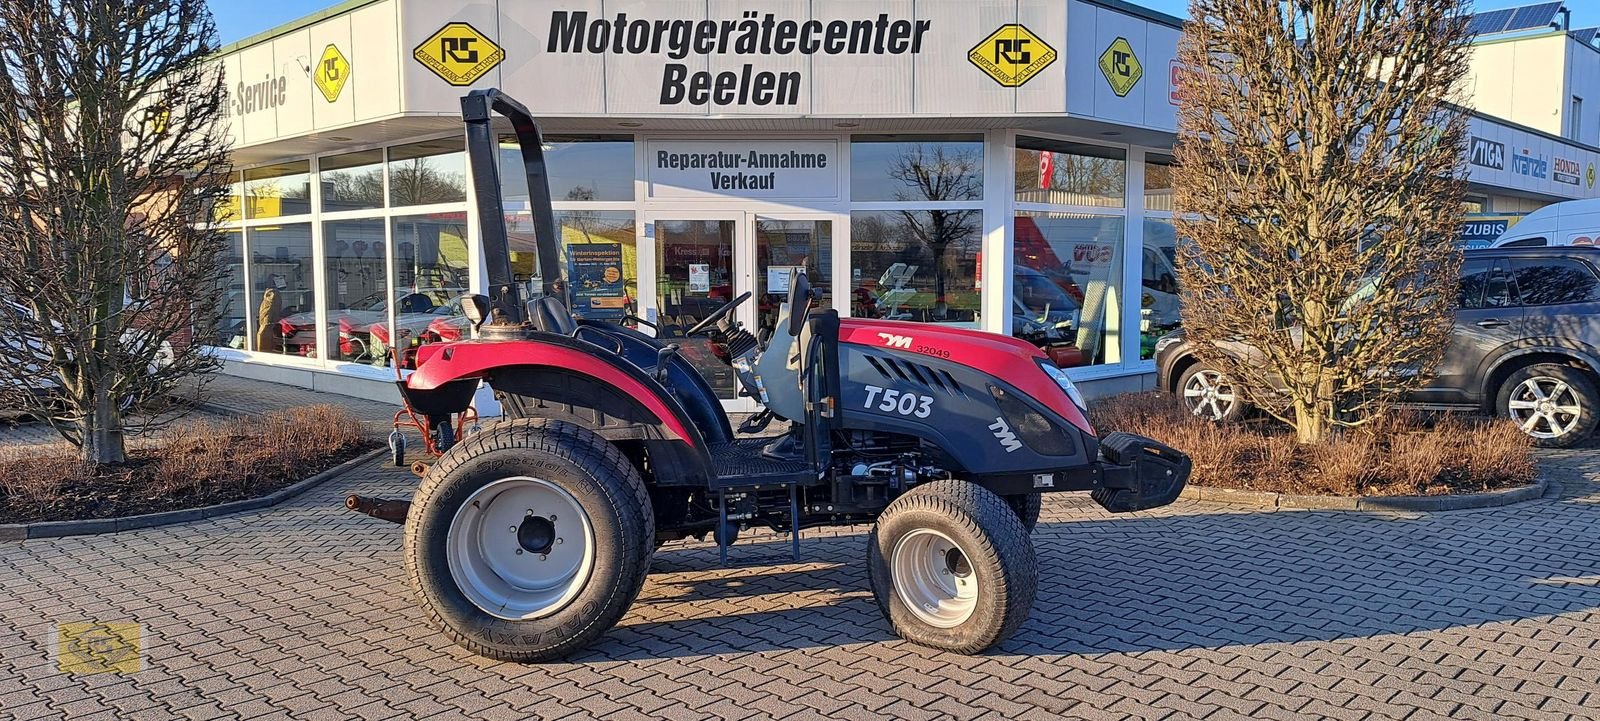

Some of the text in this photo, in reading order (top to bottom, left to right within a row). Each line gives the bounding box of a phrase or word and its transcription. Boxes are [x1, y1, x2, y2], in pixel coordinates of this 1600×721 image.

[546, 11, 931, 58] Motorgerätecenter
[659, 63, 802, 106] Beelen
[657, 150, 827, 170] Reparatur-Annahme
[1471, 140, 1503, 168] STIGA
[1554, 157, 1581, 176] HONDA
[710, 172, 776, 190] Verkauf
[1461, 224, 1505, 236] ZUBIS
[916, 344, 951, 359] 32049
[863, 385, 934, 419] T503
[987, 416, 1024, 453] TYM
[474, 600, 598, 646] GALAXY
